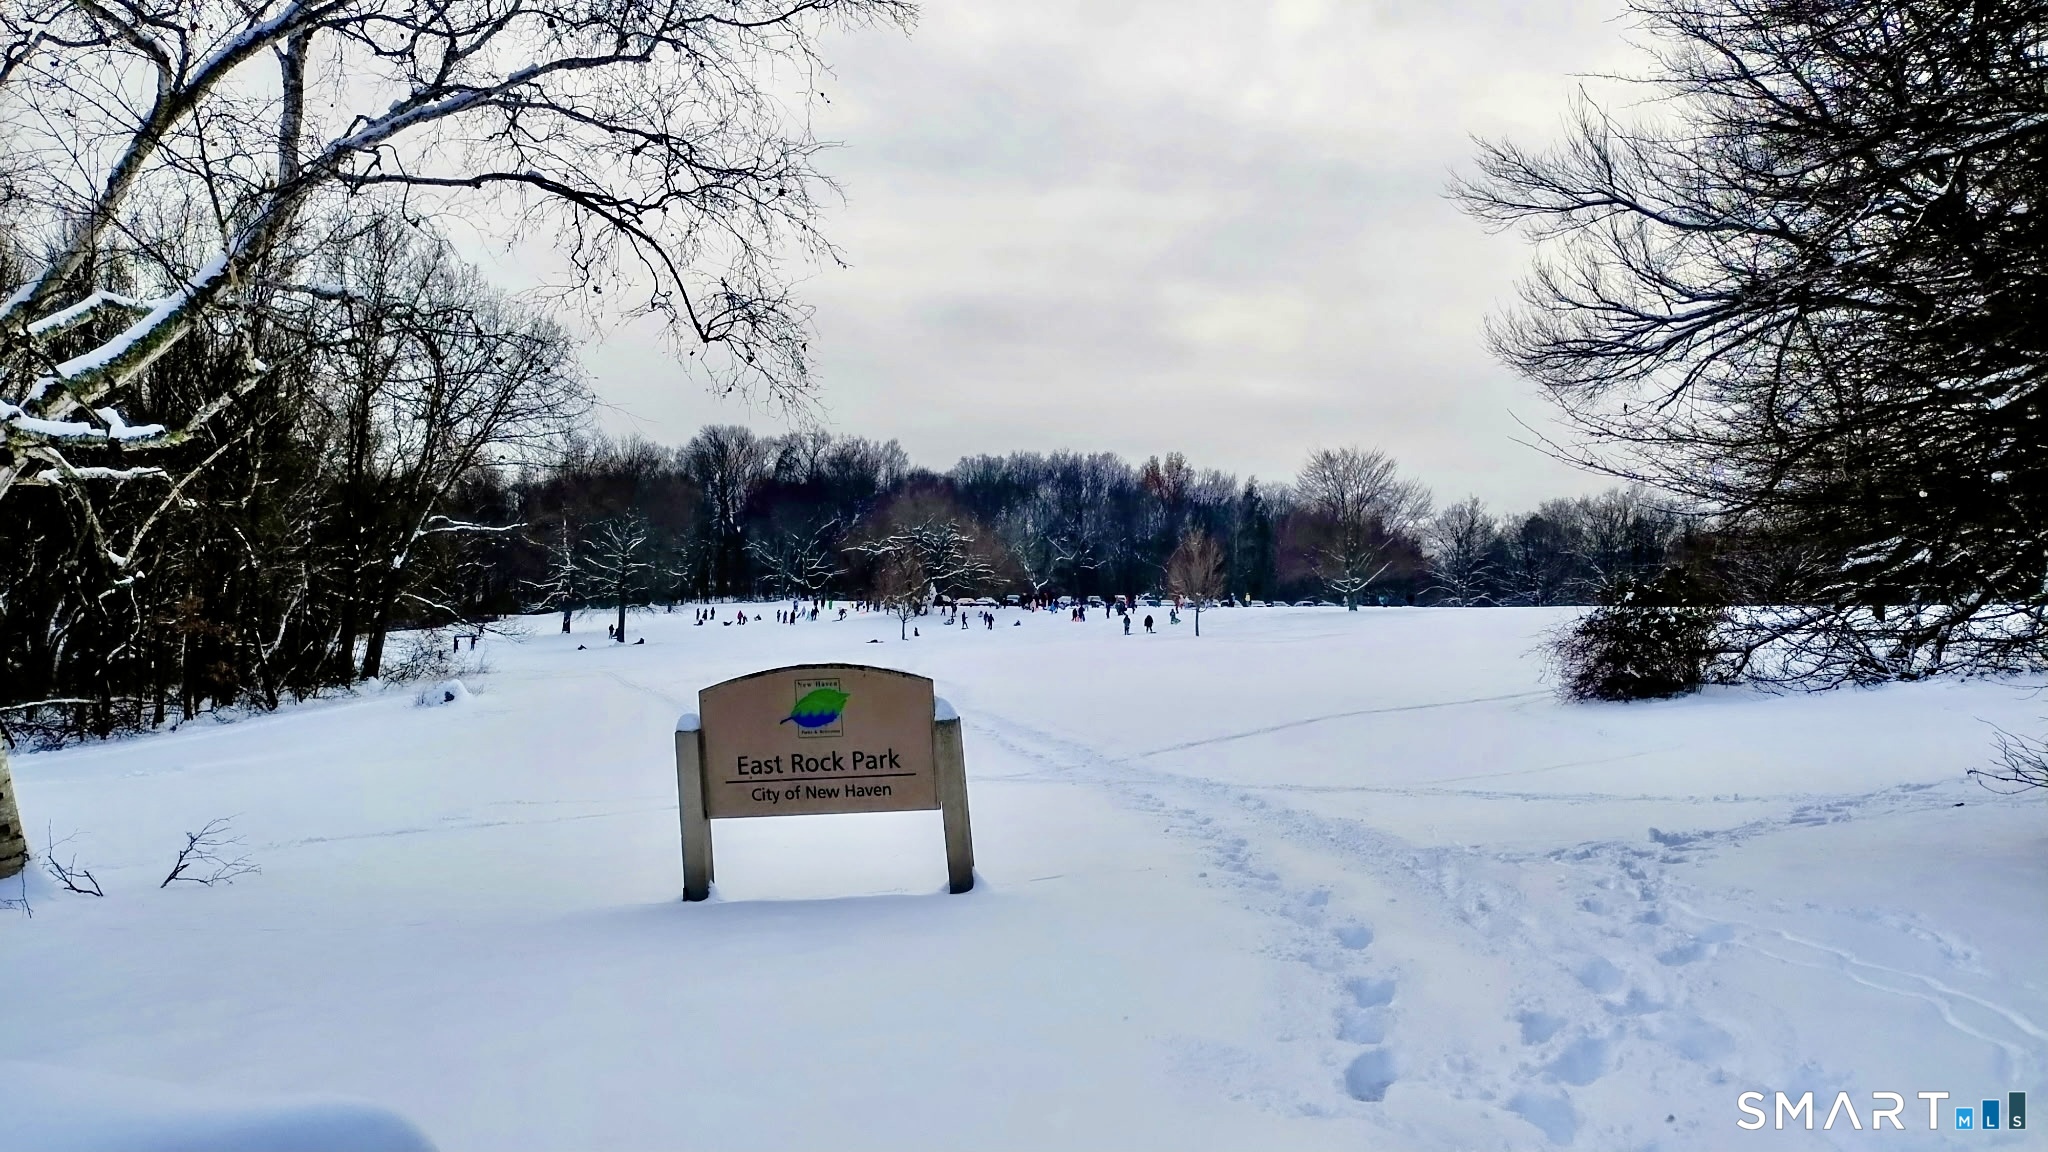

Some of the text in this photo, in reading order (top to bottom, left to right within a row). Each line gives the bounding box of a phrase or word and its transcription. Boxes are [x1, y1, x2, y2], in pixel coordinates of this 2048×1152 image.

[815, 680, 838, 688] Haven
[737, 748, 902, 776] East Rock Park
[751, 783, 892, 804] City of New Haven
